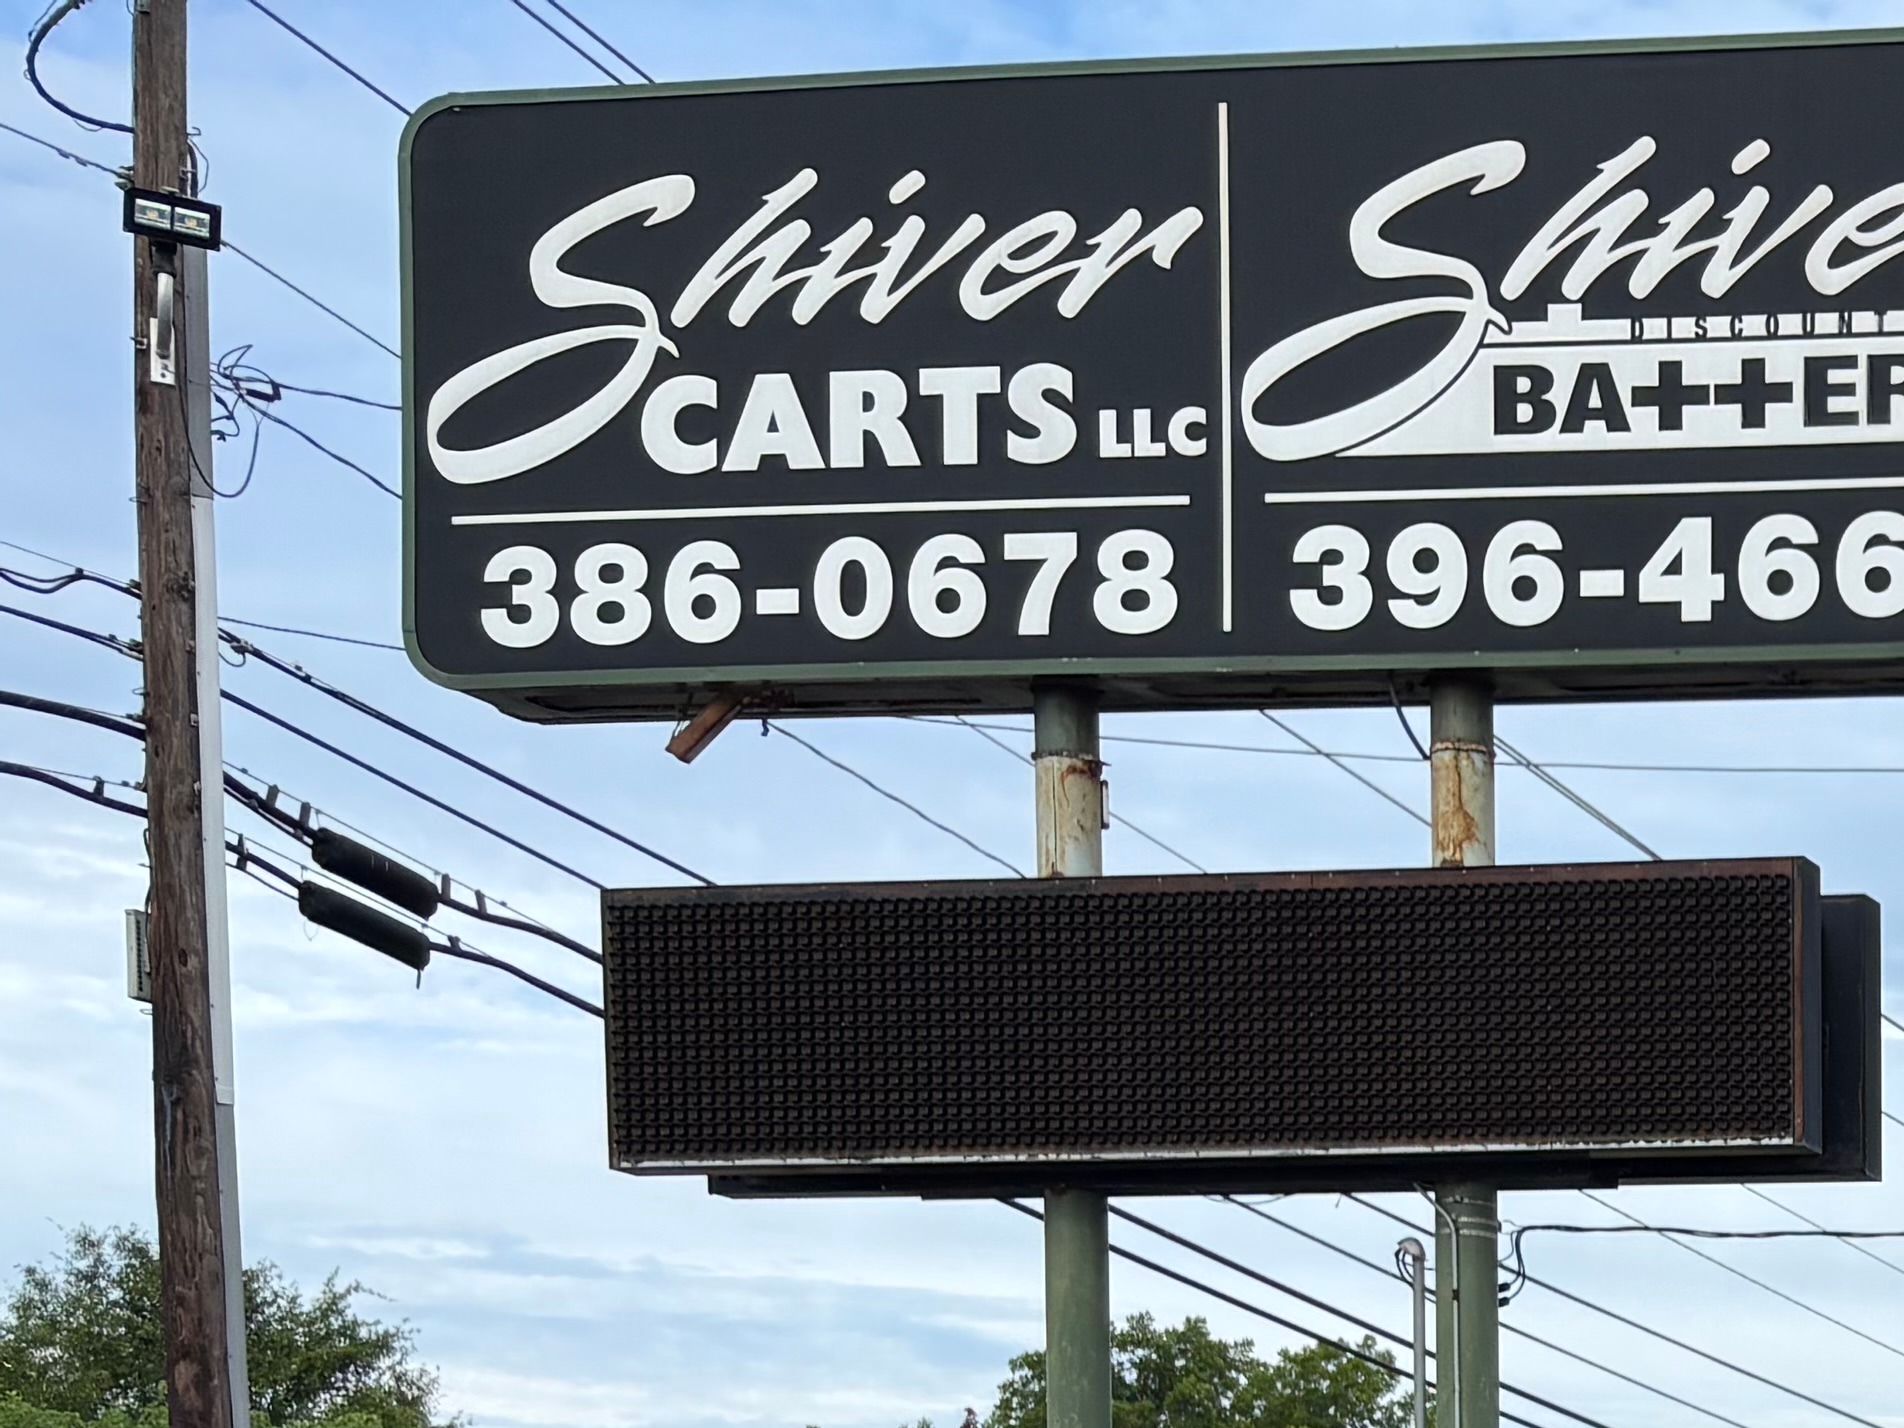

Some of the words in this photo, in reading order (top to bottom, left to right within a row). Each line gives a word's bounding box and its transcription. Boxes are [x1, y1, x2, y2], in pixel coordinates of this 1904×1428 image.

[427, 168, 1204, 484] Shiver
[1631, 310, 1888, 340] DISCOUNT
[641, 363, 1076, 474] CARTS
[1099, 407, 1206, 457] LLC
[481, 529, 1177, 647] 386-0678
